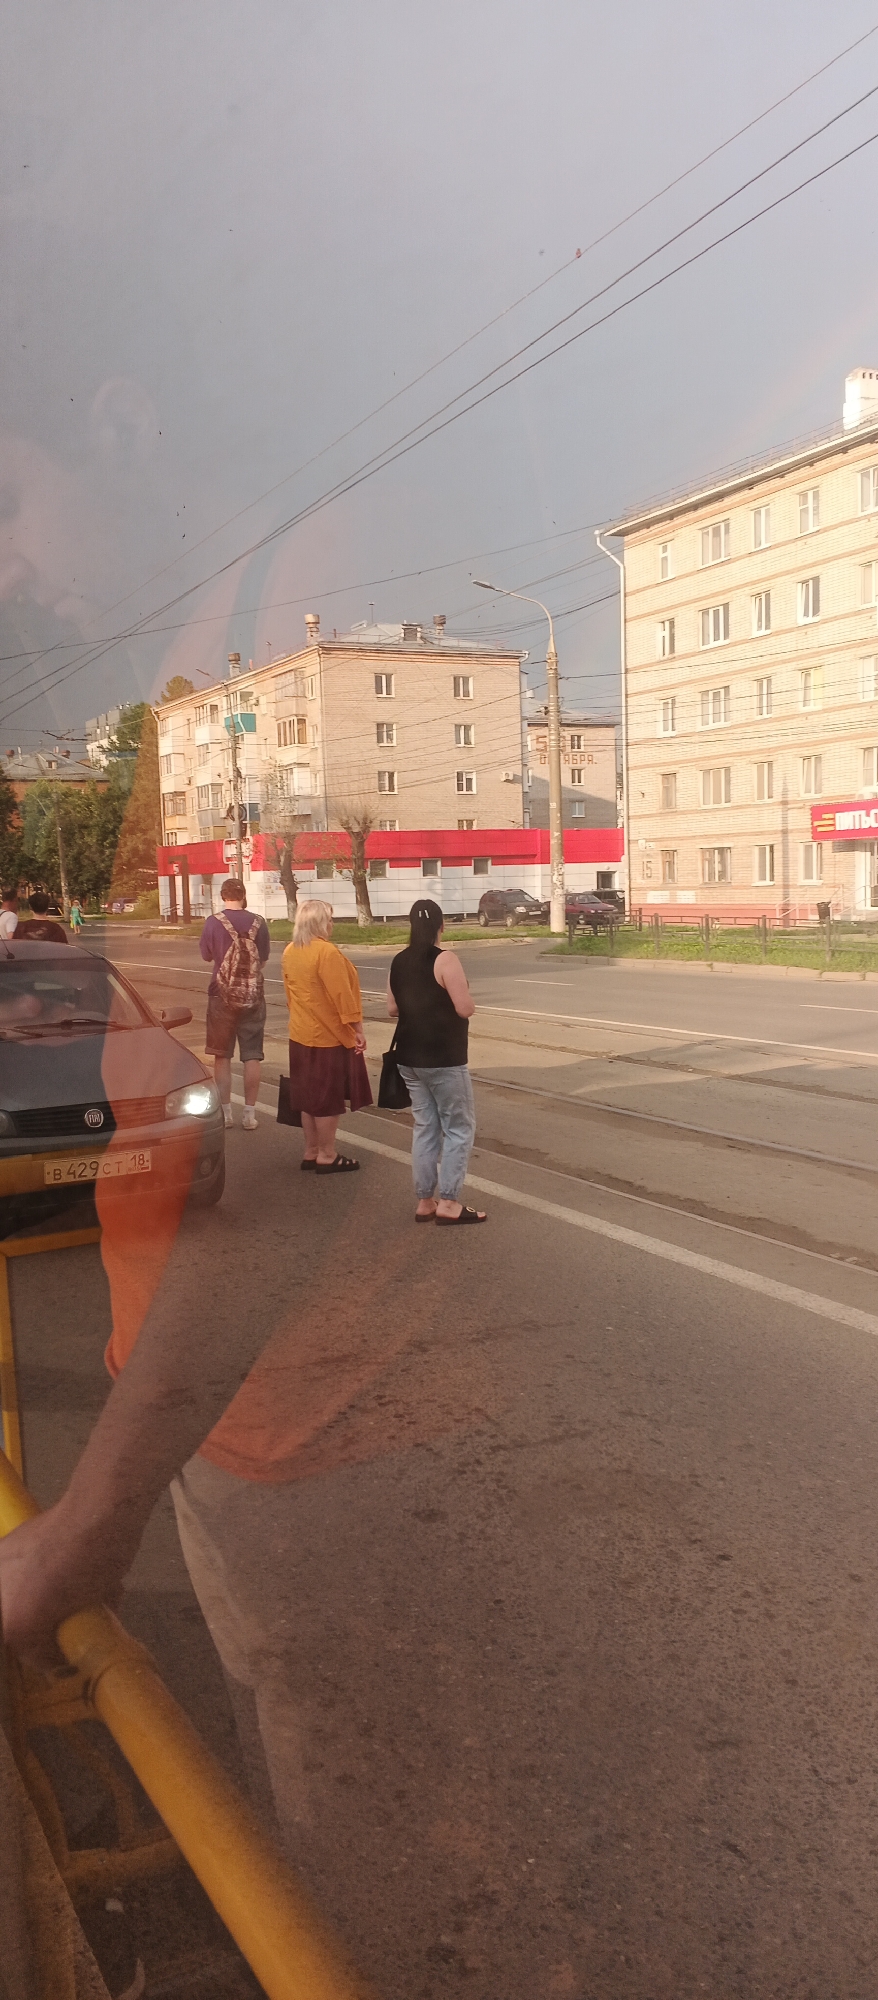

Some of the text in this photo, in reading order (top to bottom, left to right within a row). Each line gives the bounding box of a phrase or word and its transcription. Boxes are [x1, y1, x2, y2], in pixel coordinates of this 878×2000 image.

[642, 860, 653, 880] 15
[88, 1113, 101, 1123] FIAT
[130, 1153, 146, 1167] 18
